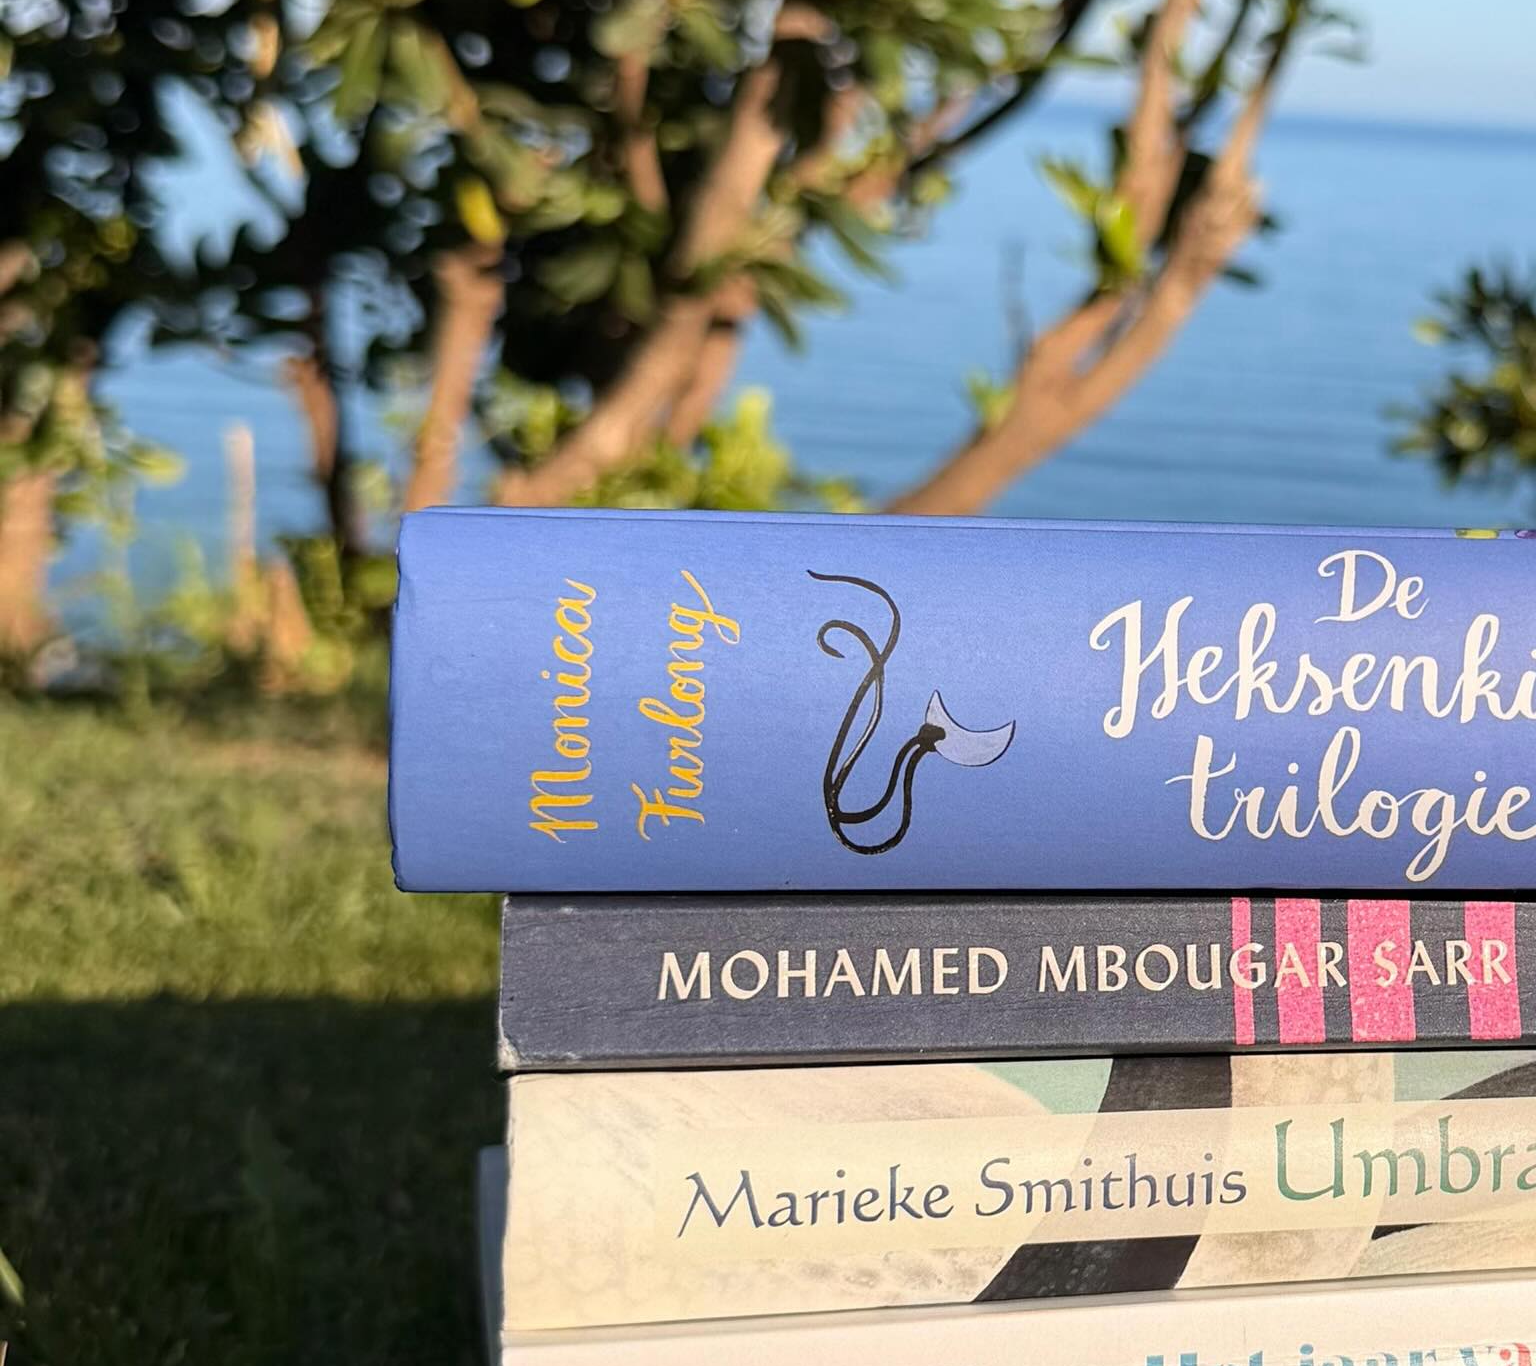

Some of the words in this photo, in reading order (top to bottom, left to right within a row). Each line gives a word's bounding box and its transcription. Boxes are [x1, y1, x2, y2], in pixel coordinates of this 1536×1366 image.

[1314, 548, 1430, 624] De
[529, 578, 598, 844] Monica
[631, 569, 741, 841] Furlong
[657, 946, 1008, 1002] MOHAMED
[1038, 939, 1347, 996] MBOUGAR
[1373, 938, 1513, 987] SARR
[678, 1163, 954, 1239] Marieke
[975, 1152, 1248, 1219] Smithuis
